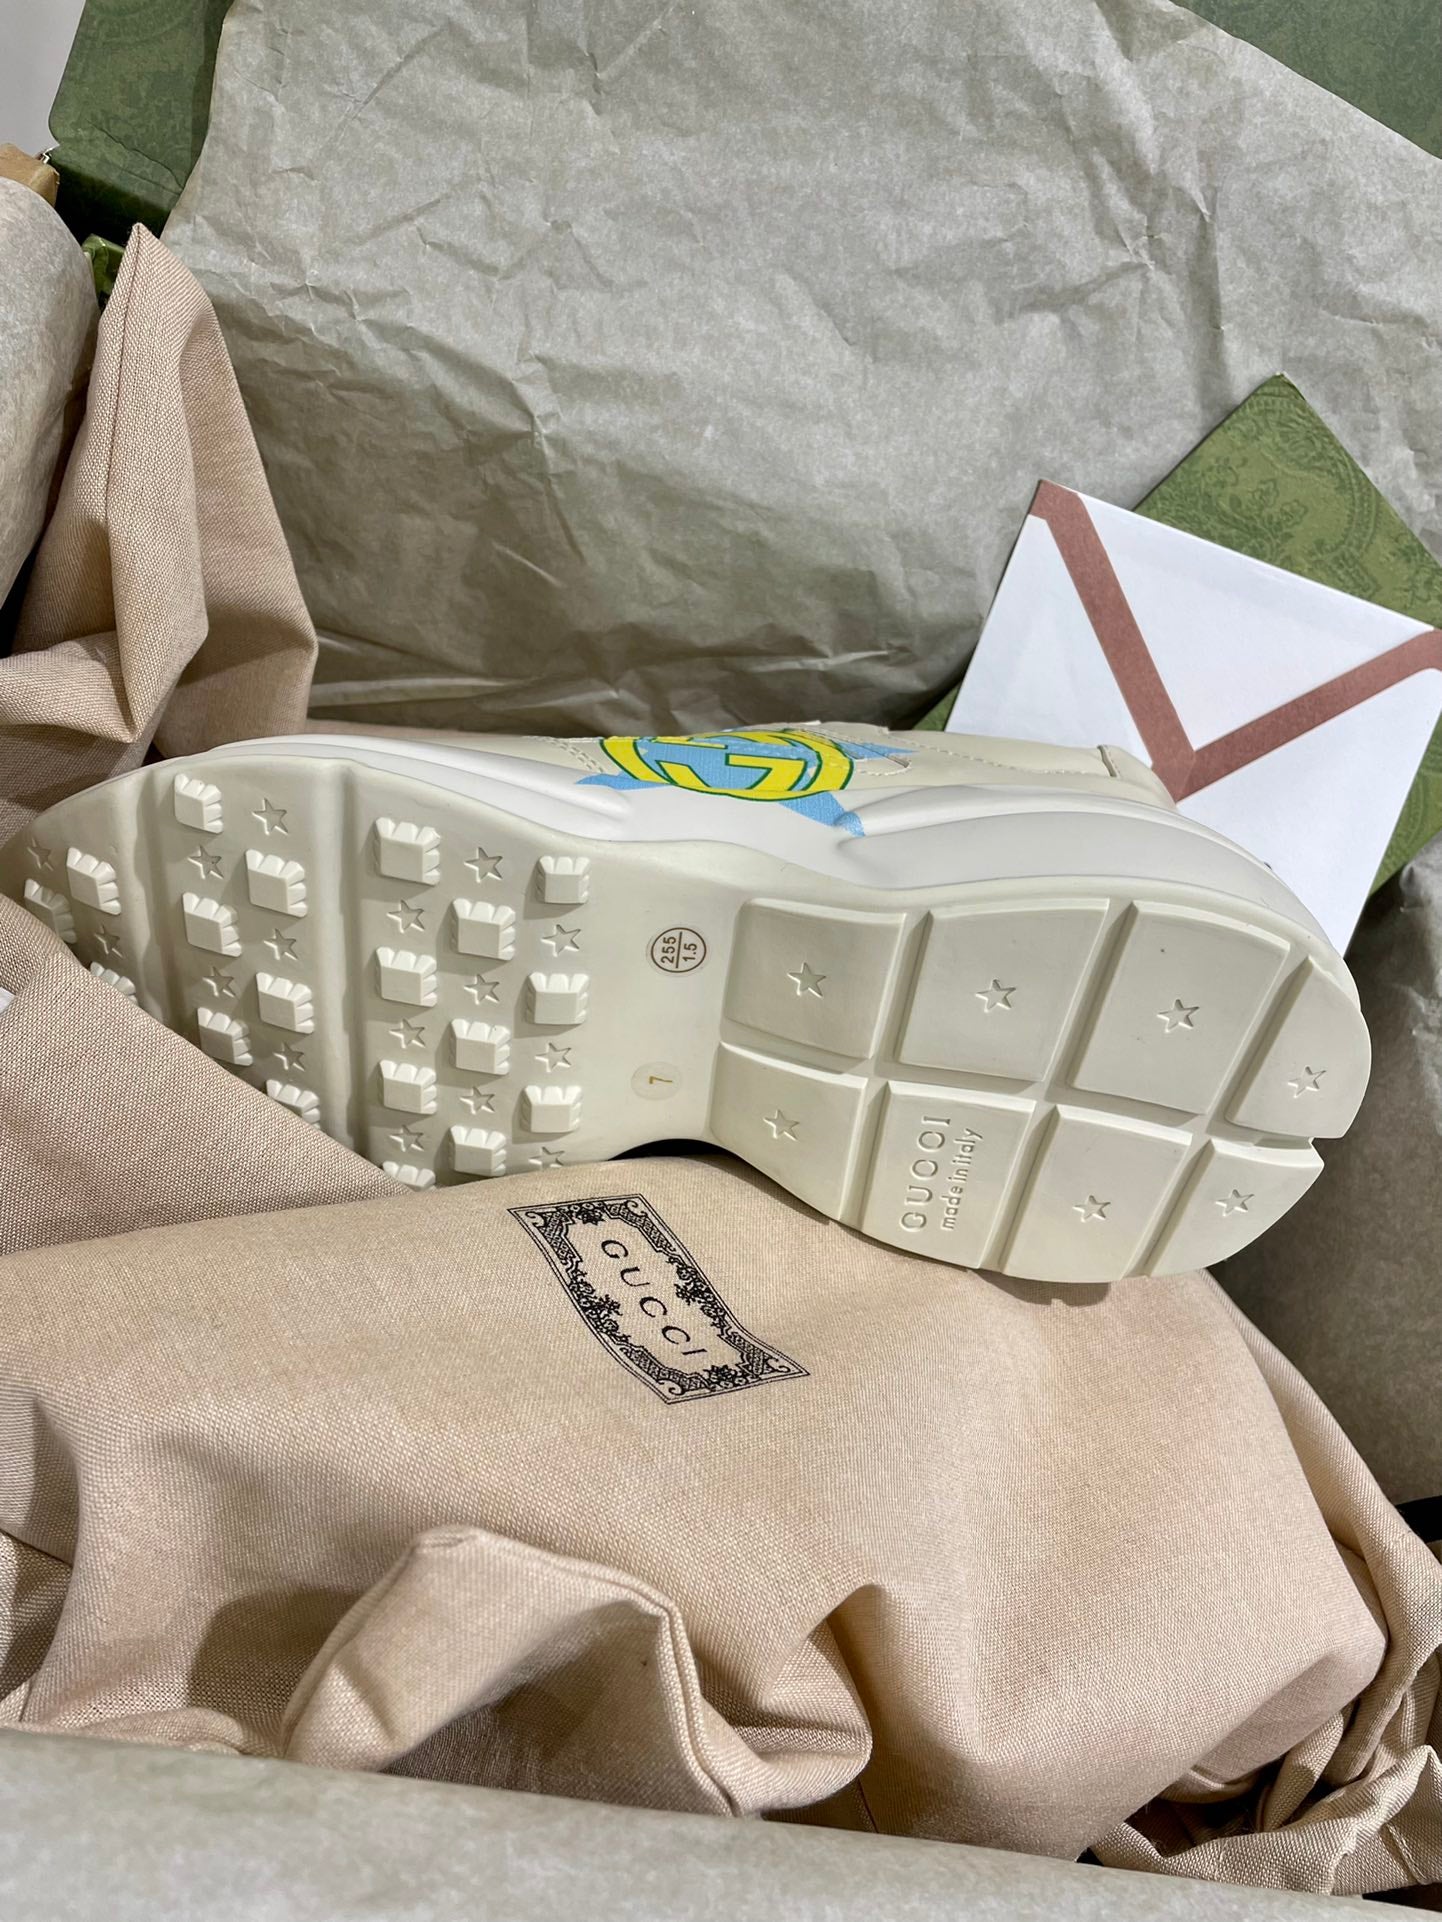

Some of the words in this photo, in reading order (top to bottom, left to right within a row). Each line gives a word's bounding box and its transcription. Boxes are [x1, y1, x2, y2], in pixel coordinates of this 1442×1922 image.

[660, 936, 677, 964] 255
[682, 942, 698, 962] 1.5
[648, 1075, 673, 1085] 7
[952, 1128, 983, 1164] italy
[900, 1116, 951, 1232] GUCCI
[946, 1168, 968, 1183] in
[940, 1186, 963, 1231] made
[600, 1239, 708, 1357] GUCCI
